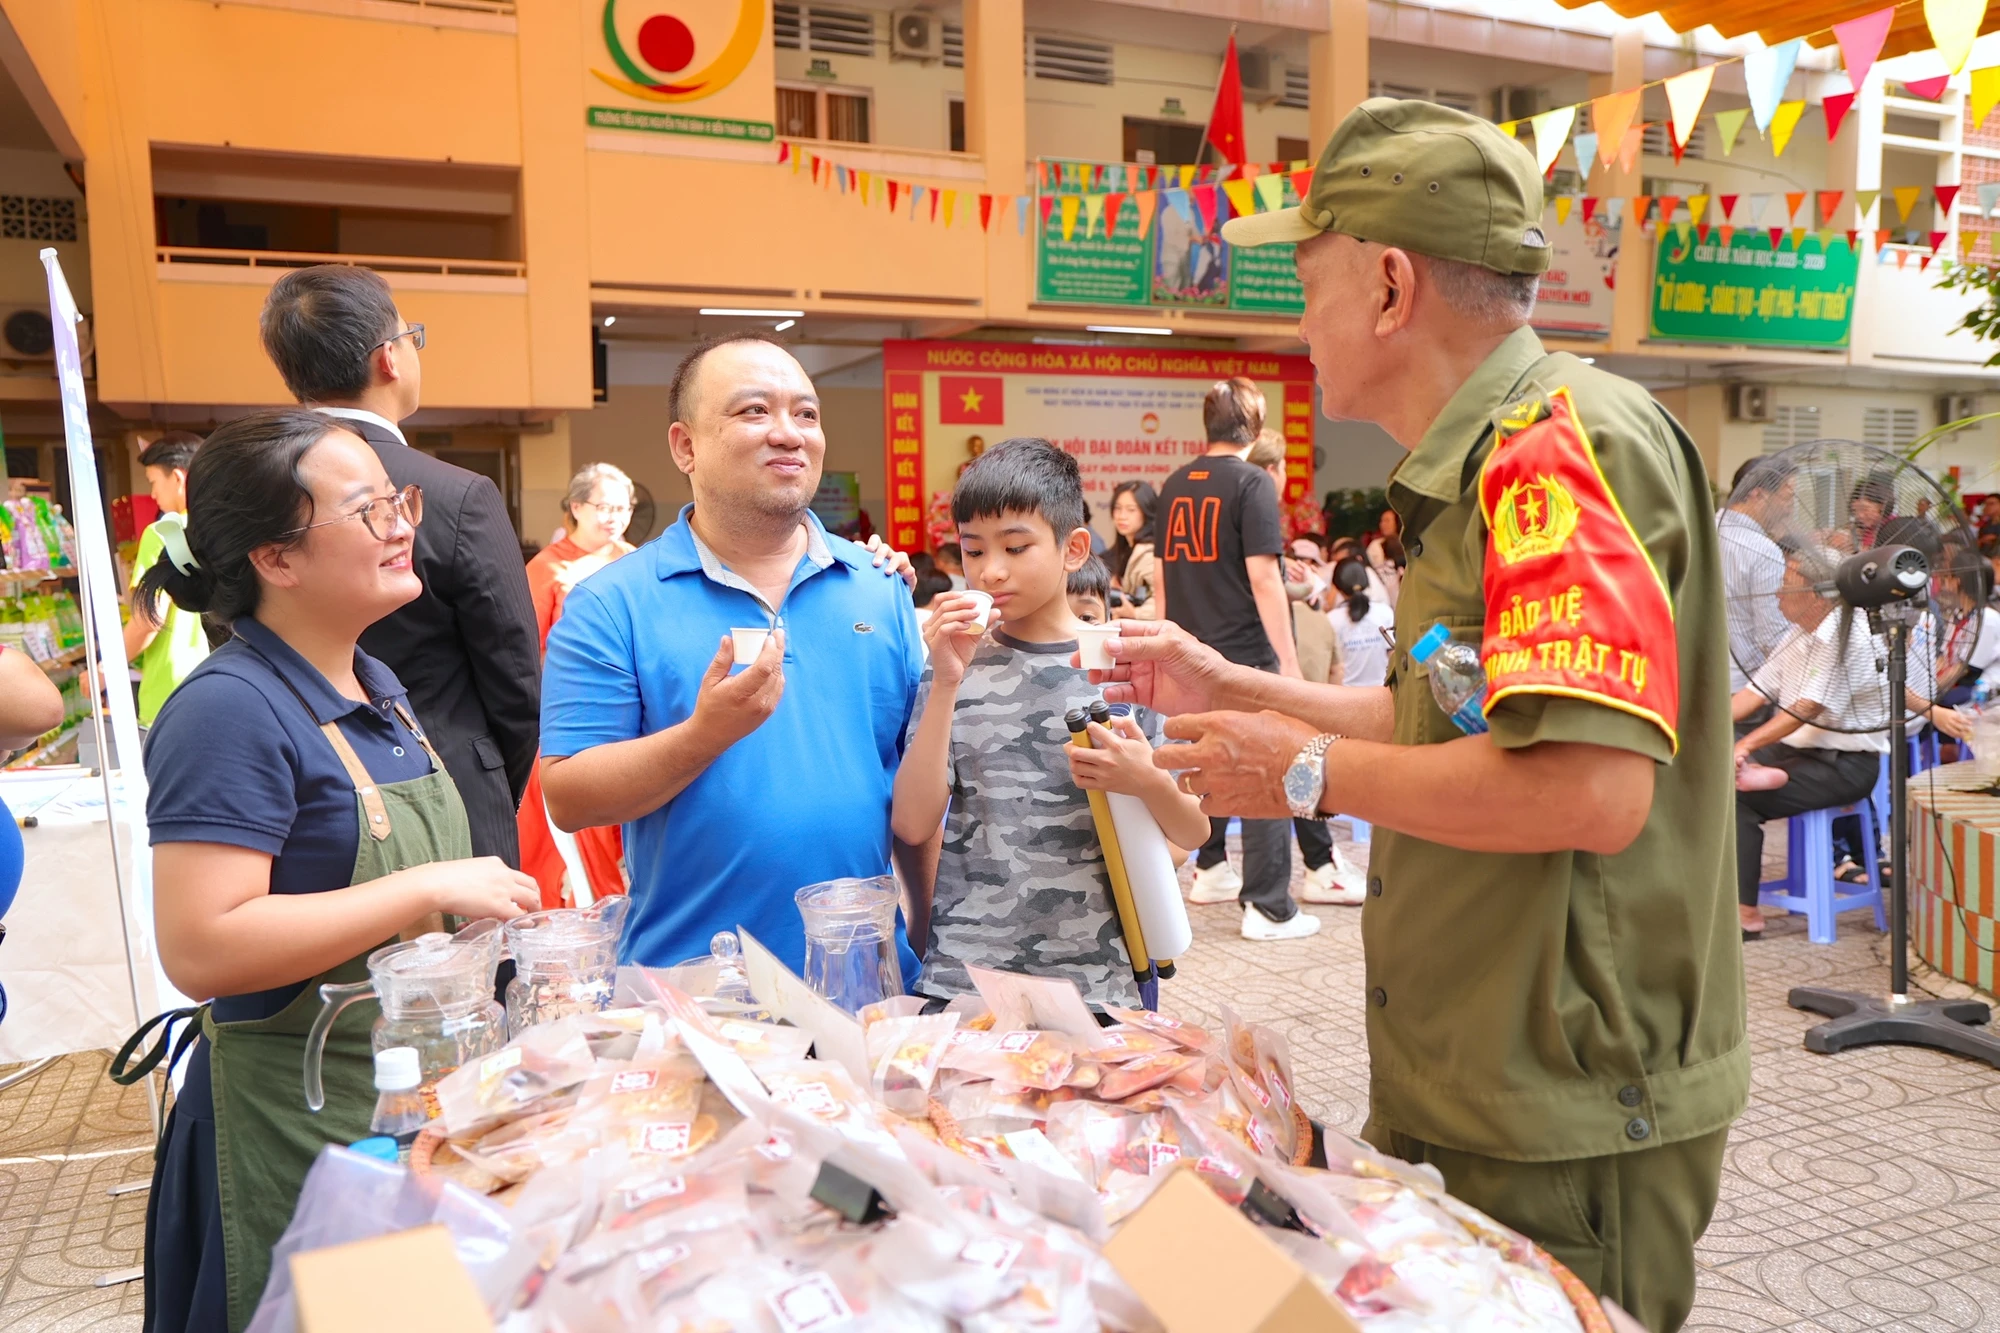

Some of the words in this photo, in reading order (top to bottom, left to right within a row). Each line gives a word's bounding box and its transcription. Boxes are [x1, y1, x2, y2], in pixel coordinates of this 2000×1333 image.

[927, 347, 975, 366] NƯỚC
[979, 348, 1027, 368] CỘNG
[1031, 350, 1067, 369] HÒA
[1070, 351, 1092, 370] XÃ
[1095, 352, 1123, 373] HỘI
[1125, 352, 1158, 372] CHỦ
[1161, 355, 1209, 374] NGHĨA
[1212, 357, 1244, 376] VIỆT
[1247, 362, 1280, 376] NAM
[1063, 435, 1085, 458] HỘI
[1089, 439, 1112, 459] ĐẠI
[1115, 437, 1151, 456] ĐOÀN
[1155, 436, 1175, 456] KẾT
[1182, 437, 1209, 456] TOÀ
[1165, 497, 1221, 562] AI
[1500, 594, 1541, 638] BẢO
[1549, 584, 1582, 628] VỆ
[1537, 634, 1611, 678] TRẬT
[1619, 649, 1648, 694] TỰ
